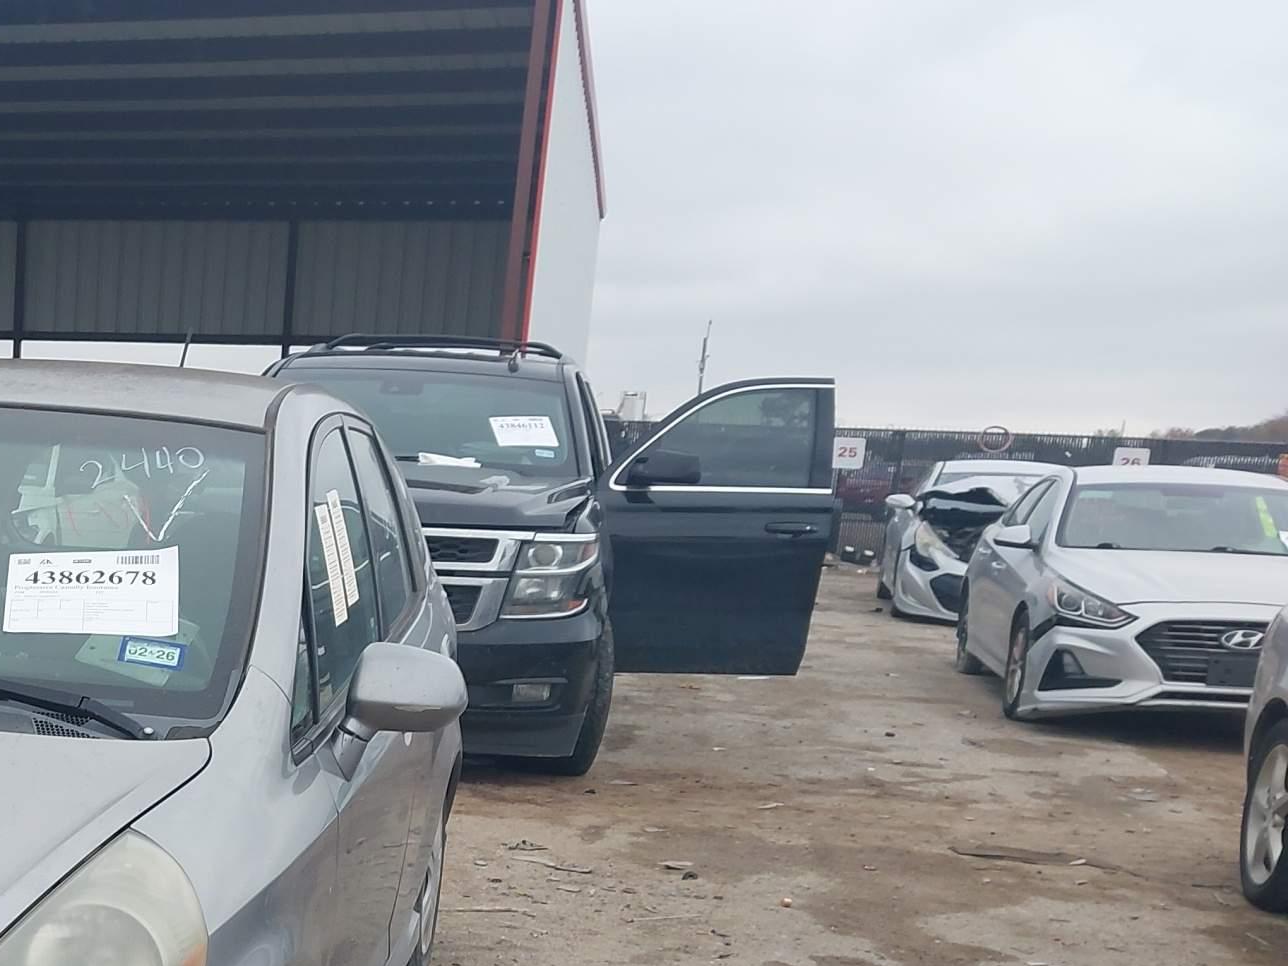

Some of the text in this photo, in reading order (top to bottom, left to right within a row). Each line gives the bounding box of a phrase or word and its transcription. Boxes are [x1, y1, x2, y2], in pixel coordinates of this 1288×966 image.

[838, 446, 857, 458] 25
[79, 446, 205, 489] 2440
[24, 570, 157, 586] 43862678
[155, 649, 176, 661] 26
